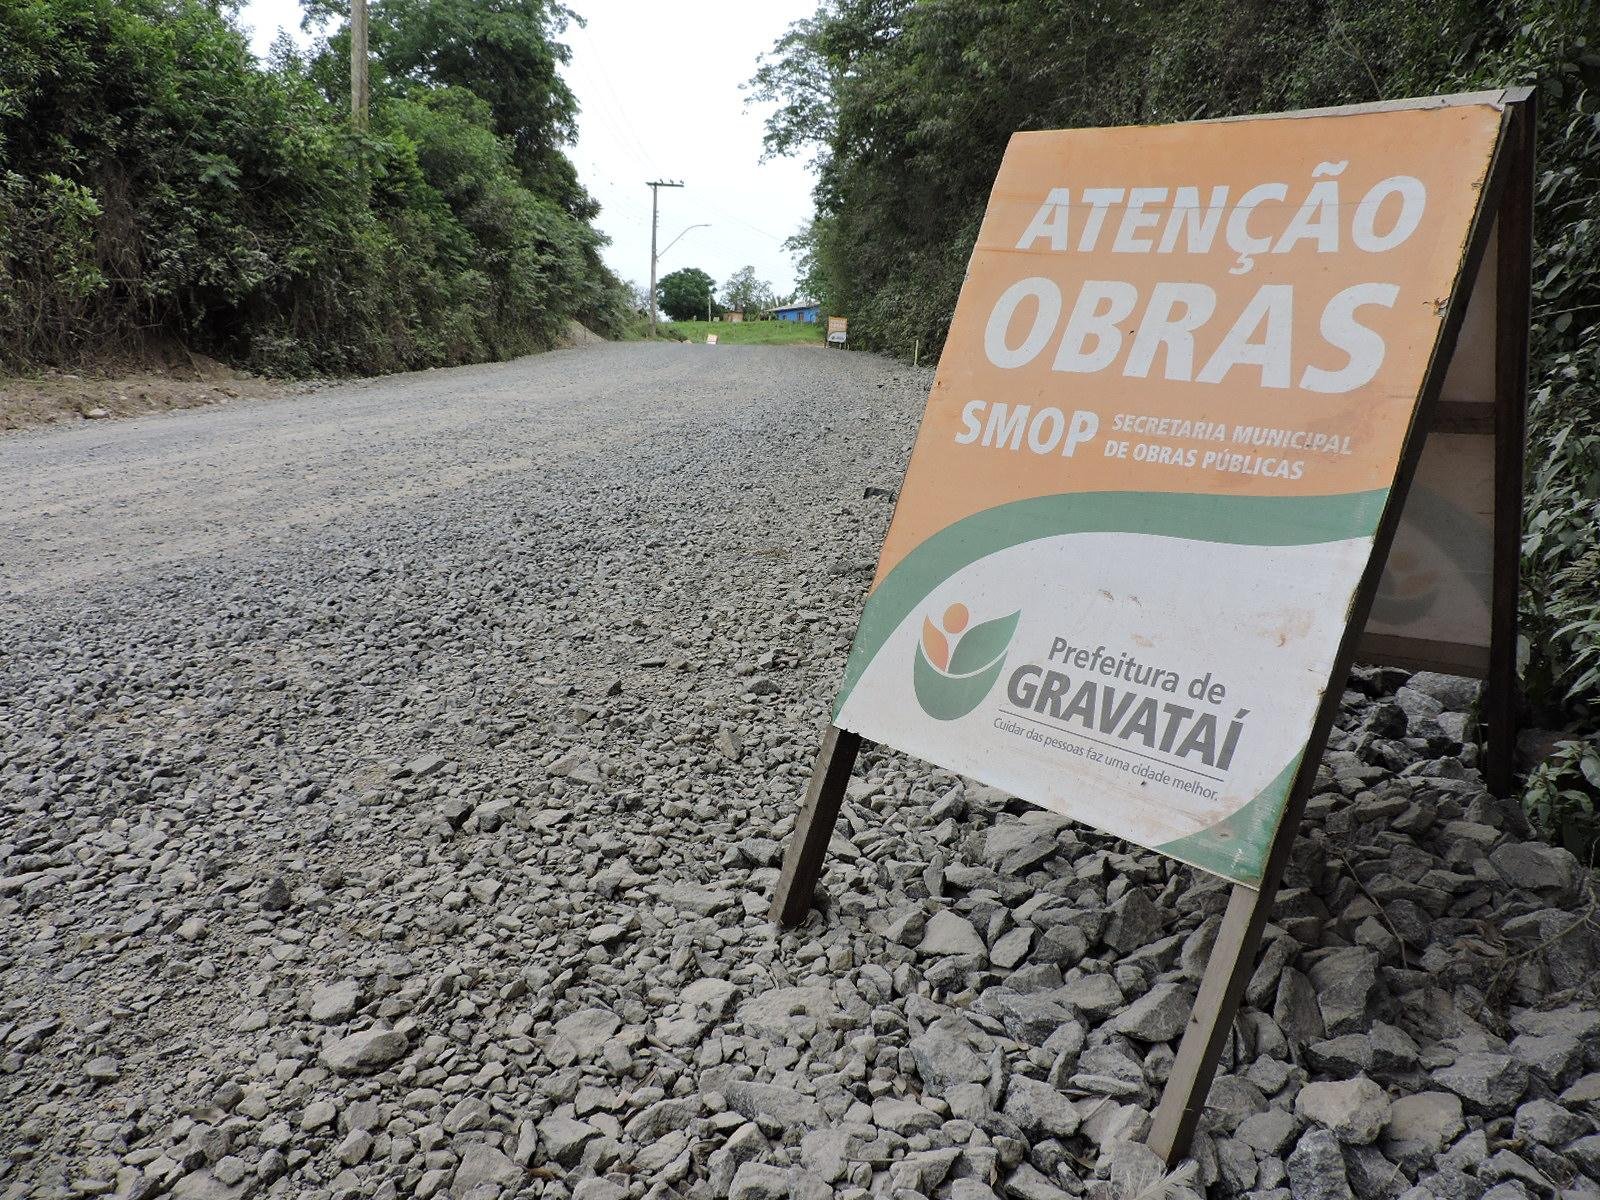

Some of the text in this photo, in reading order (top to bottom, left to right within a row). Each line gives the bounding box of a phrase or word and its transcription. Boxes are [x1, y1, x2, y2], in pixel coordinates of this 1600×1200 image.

[1015, 160, 1426, 275] ATENÇÃO
[984, 277, 1400, 394] OBRAS
[955, 400, 1099, 457] SMOP
[1104, 439, 1305, 480] DE OBRAS PÚBLICAS
[1112, 414, 1353, 455] SECRETARIA MUNICIPAL
[1048, 636, 1226, 705] Prefeitura de
[1007, 664, 1251, 771] GRAVATAÍ
[993, 717, 1218, 801] Cuidar das pessoas faz uma cidade melhor.
